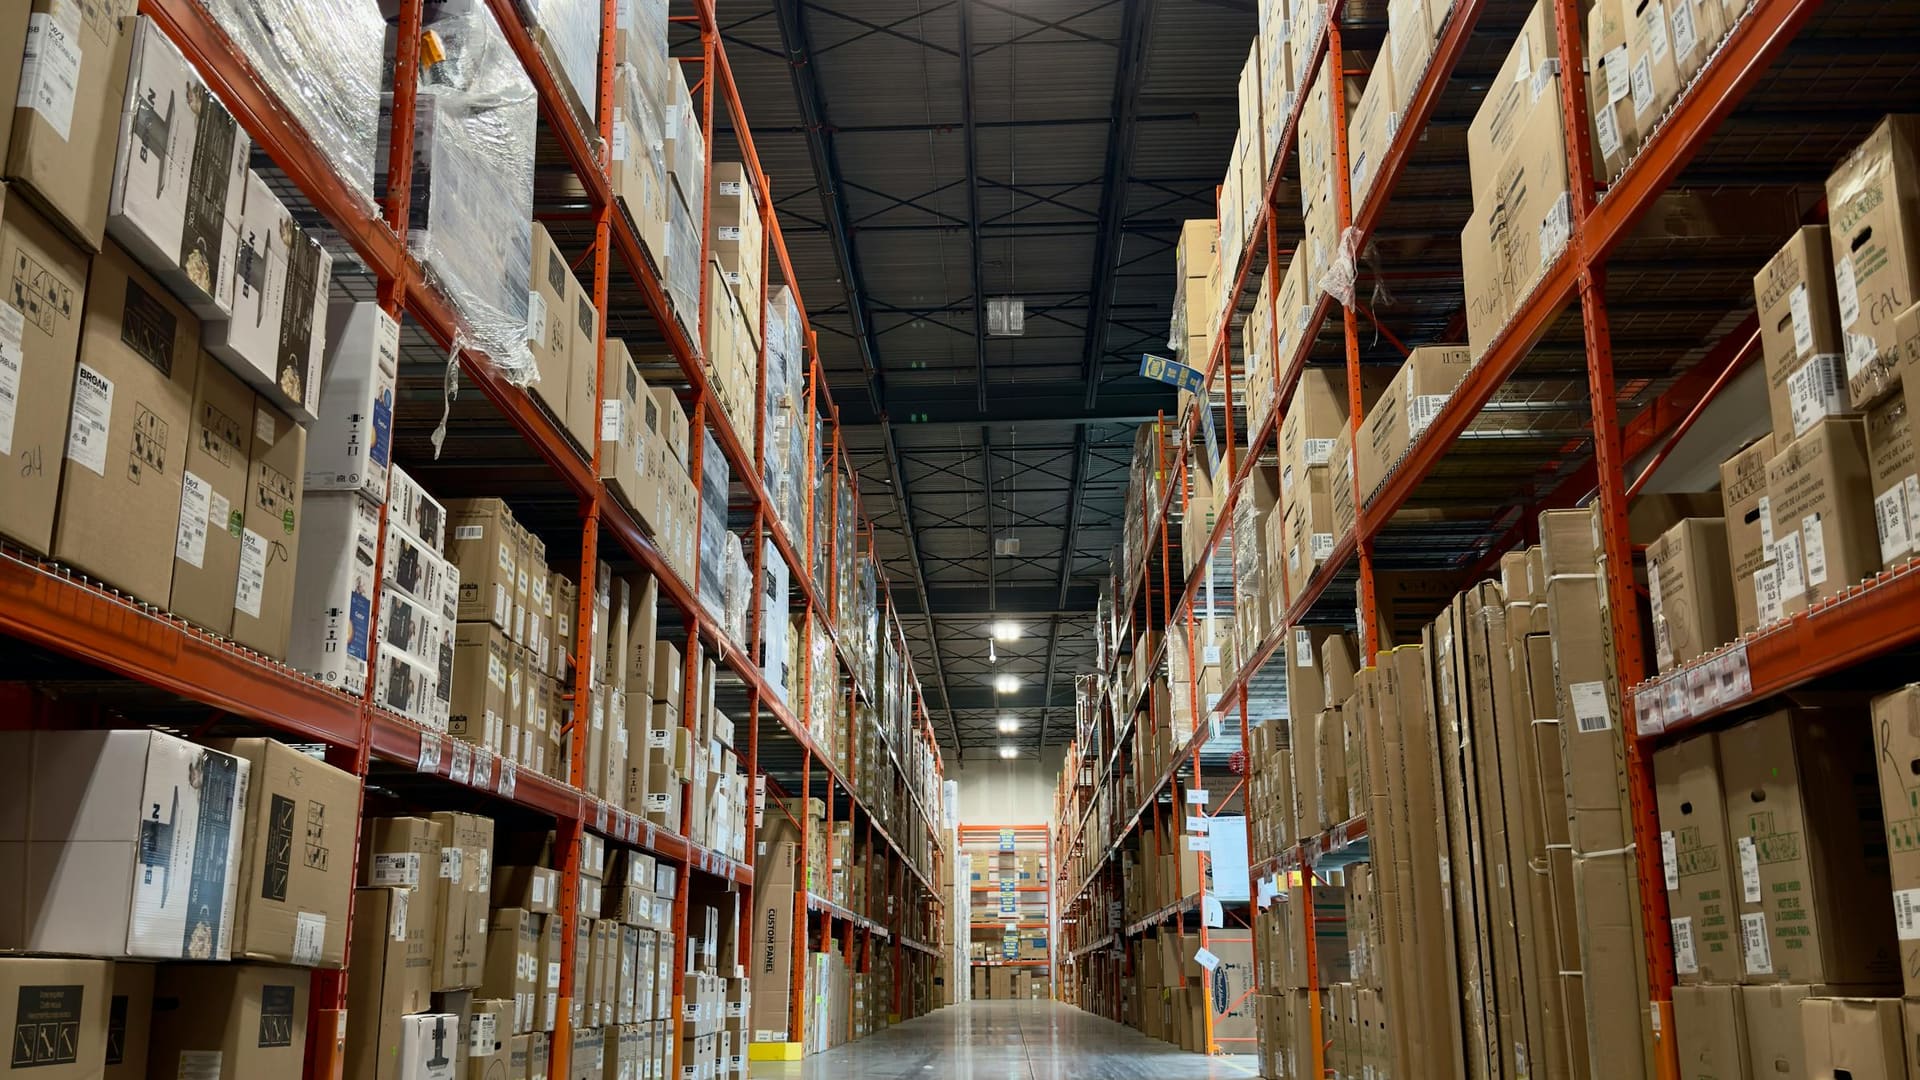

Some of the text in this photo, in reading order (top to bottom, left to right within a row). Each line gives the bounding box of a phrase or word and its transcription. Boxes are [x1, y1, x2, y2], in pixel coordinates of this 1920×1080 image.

[80, 368, 108, 392] BROAN
[21, 446, 42, 477] 24
[766, 908, 776, 974] CUSTOM PANEL
